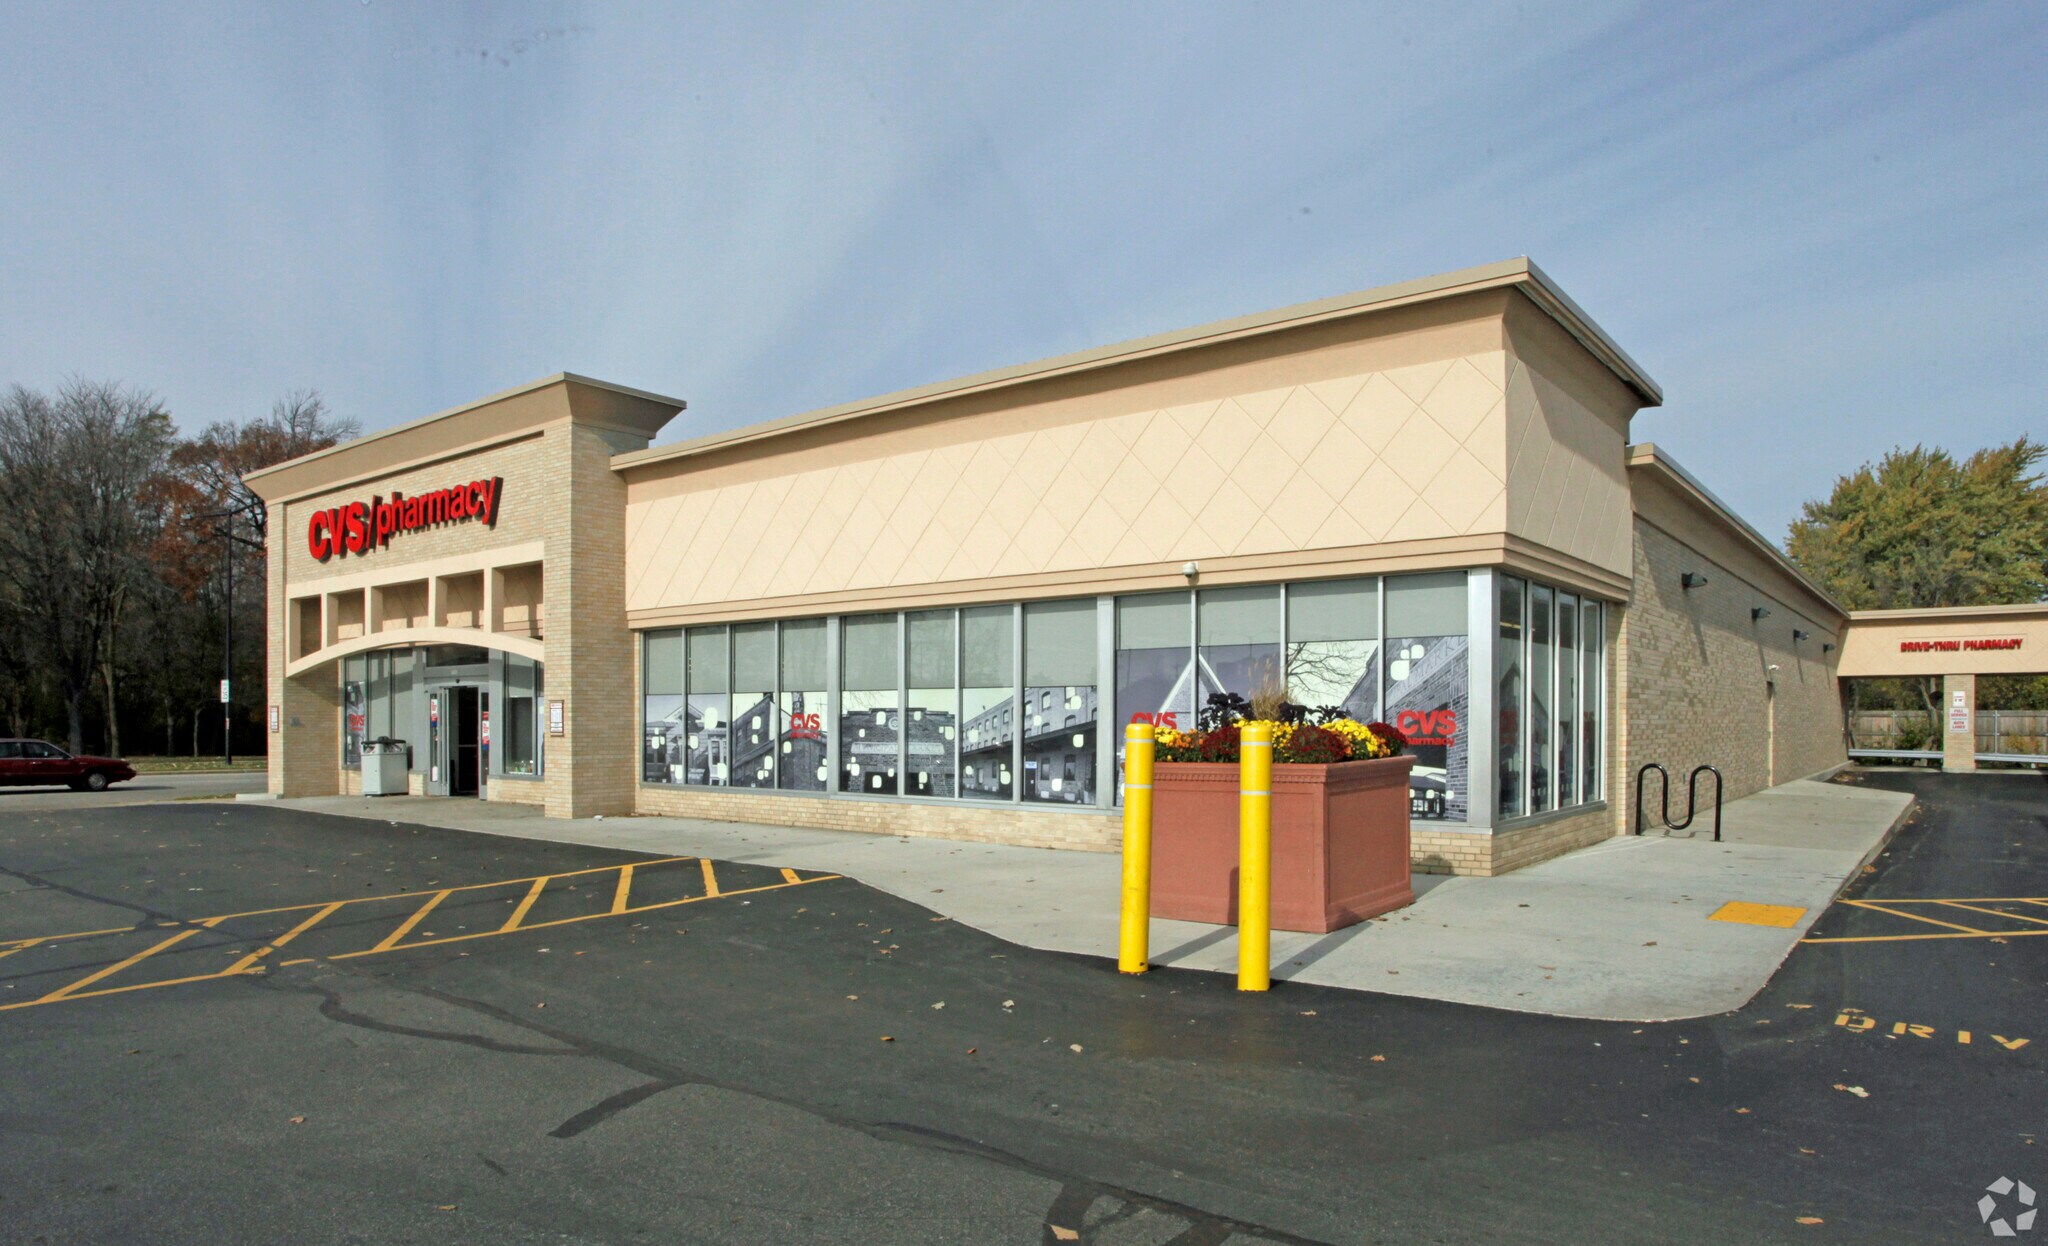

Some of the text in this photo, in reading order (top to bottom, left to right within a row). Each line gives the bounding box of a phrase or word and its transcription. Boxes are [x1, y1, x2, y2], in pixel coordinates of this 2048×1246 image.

[308, 476, 504, 562] CVS/pharmacy
[1900, 638, 2024, 653] DRIVE-THRU PHARMACY
[791, 712, 821, 731] CVS
[1396, 709, 1457, 736] CVS
